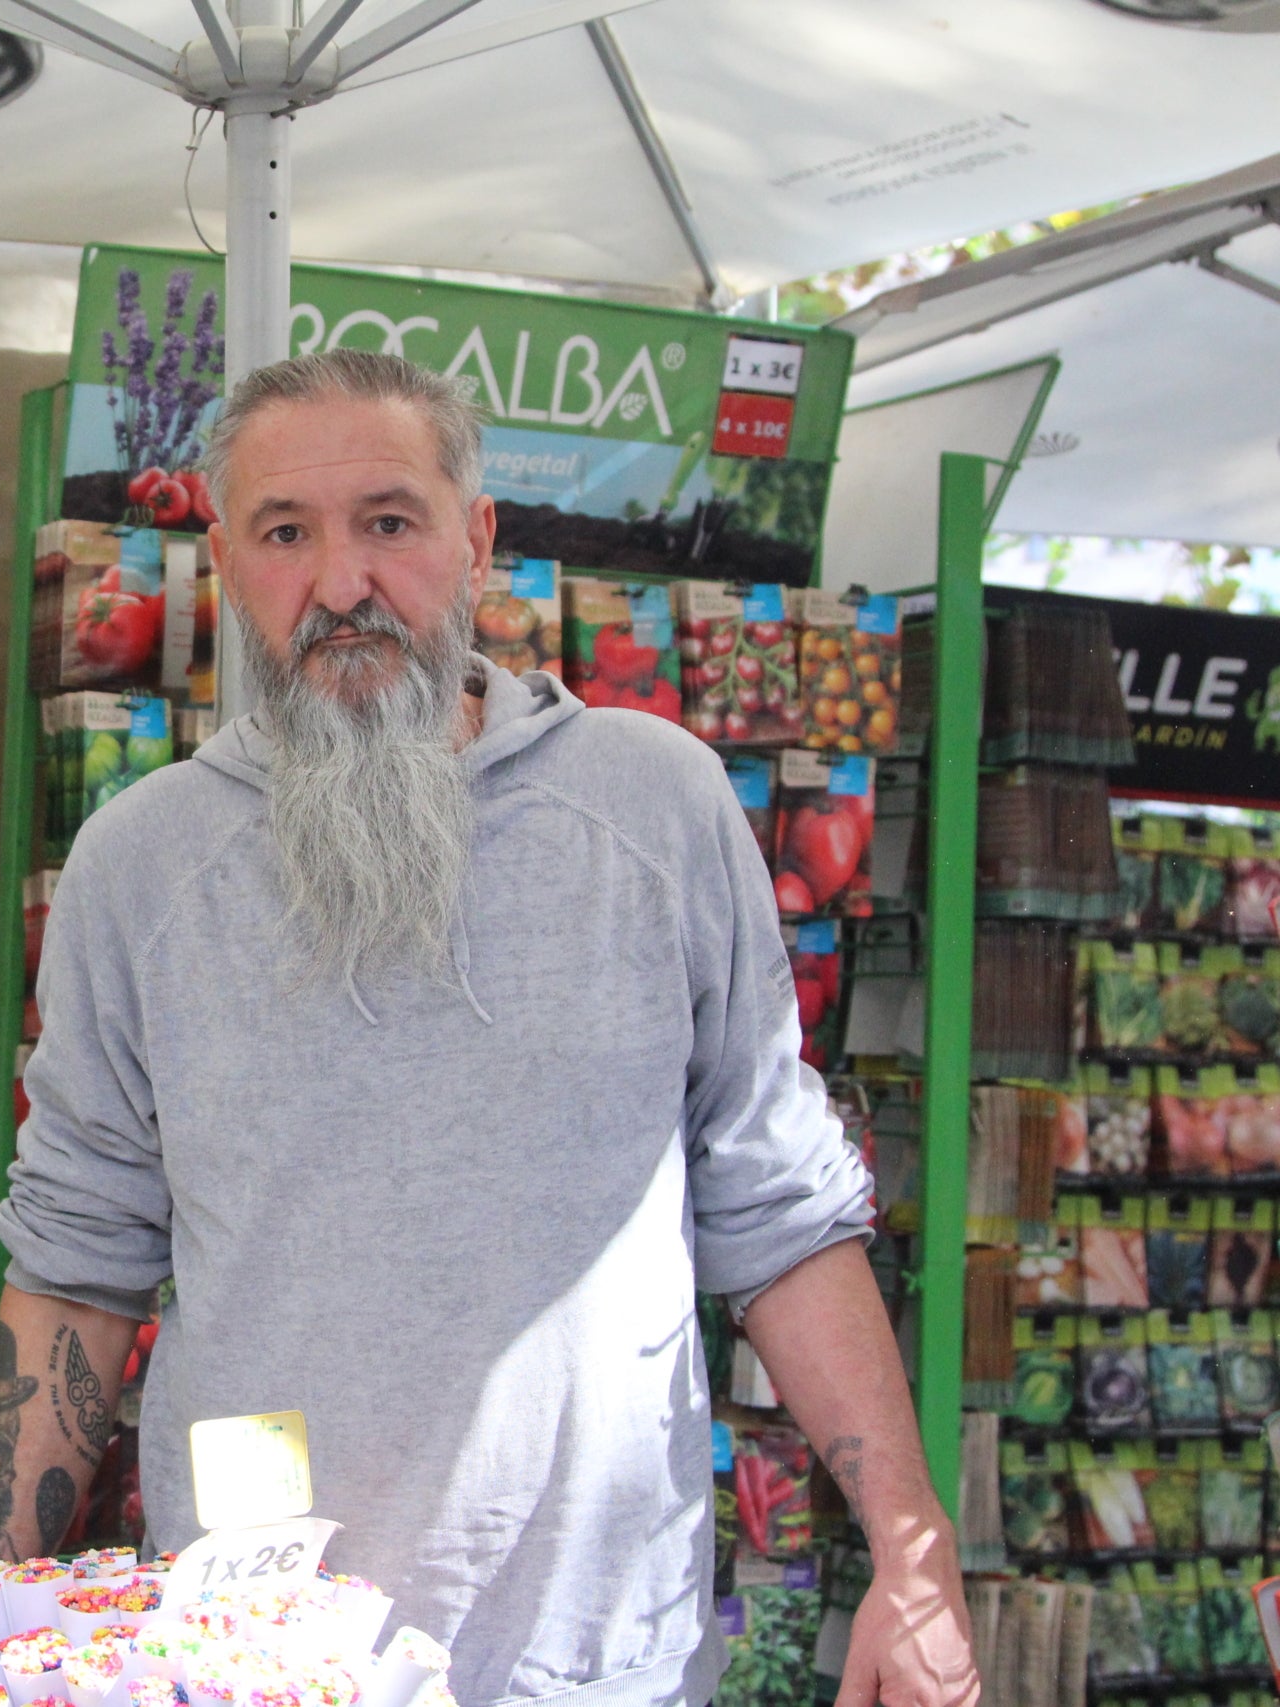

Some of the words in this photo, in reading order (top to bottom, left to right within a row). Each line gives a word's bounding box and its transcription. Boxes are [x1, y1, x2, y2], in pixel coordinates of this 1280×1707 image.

[730, 357, 741, 374] 1
[750, 362, 762, 376] x
[768, 361, 795, 380] 3€
[719, 417, 731, 433] 4
[735, 422, 747, 435] x
[752, 420, 787, 439] 10€
[482, 448, 579, 478] vegetal
[1112, 647, 1248, 719] LLE
[1134, 723, 1228, 750] ARDÍN
[201, 1555, 217, 1586] 1
[219, 1557, 246, 1583] x
[247, 1541, 305, 1578] 2€
